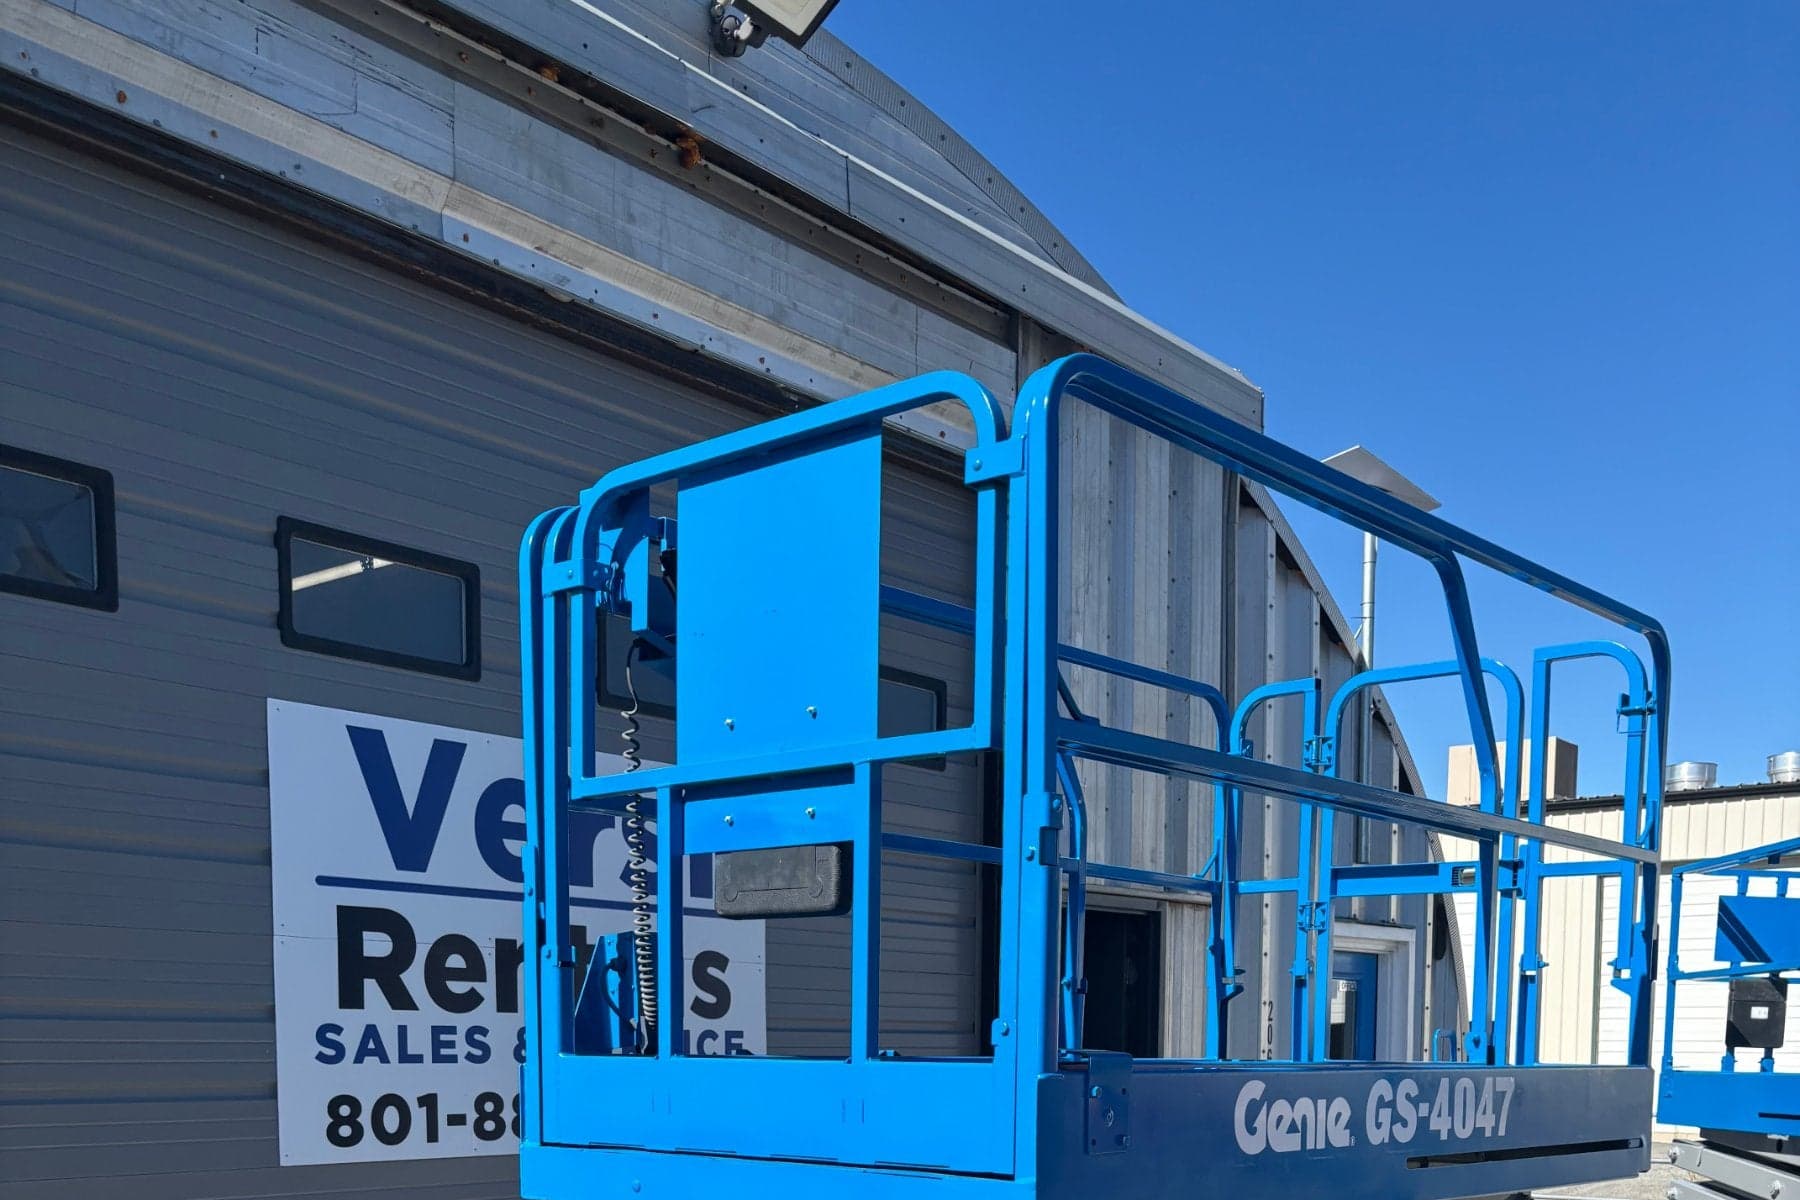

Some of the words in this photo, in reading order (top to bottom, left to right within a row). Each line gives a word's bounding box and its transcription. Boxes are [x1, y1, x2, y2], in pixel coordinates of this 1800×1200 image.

[314, 1023, 492, 1065] SALES
[325, 1092, 520, 1148] 801-8
[1234, 1079, 1351, 1155] Genie
[1366, 1076, 1515, 1146] GS-4047
